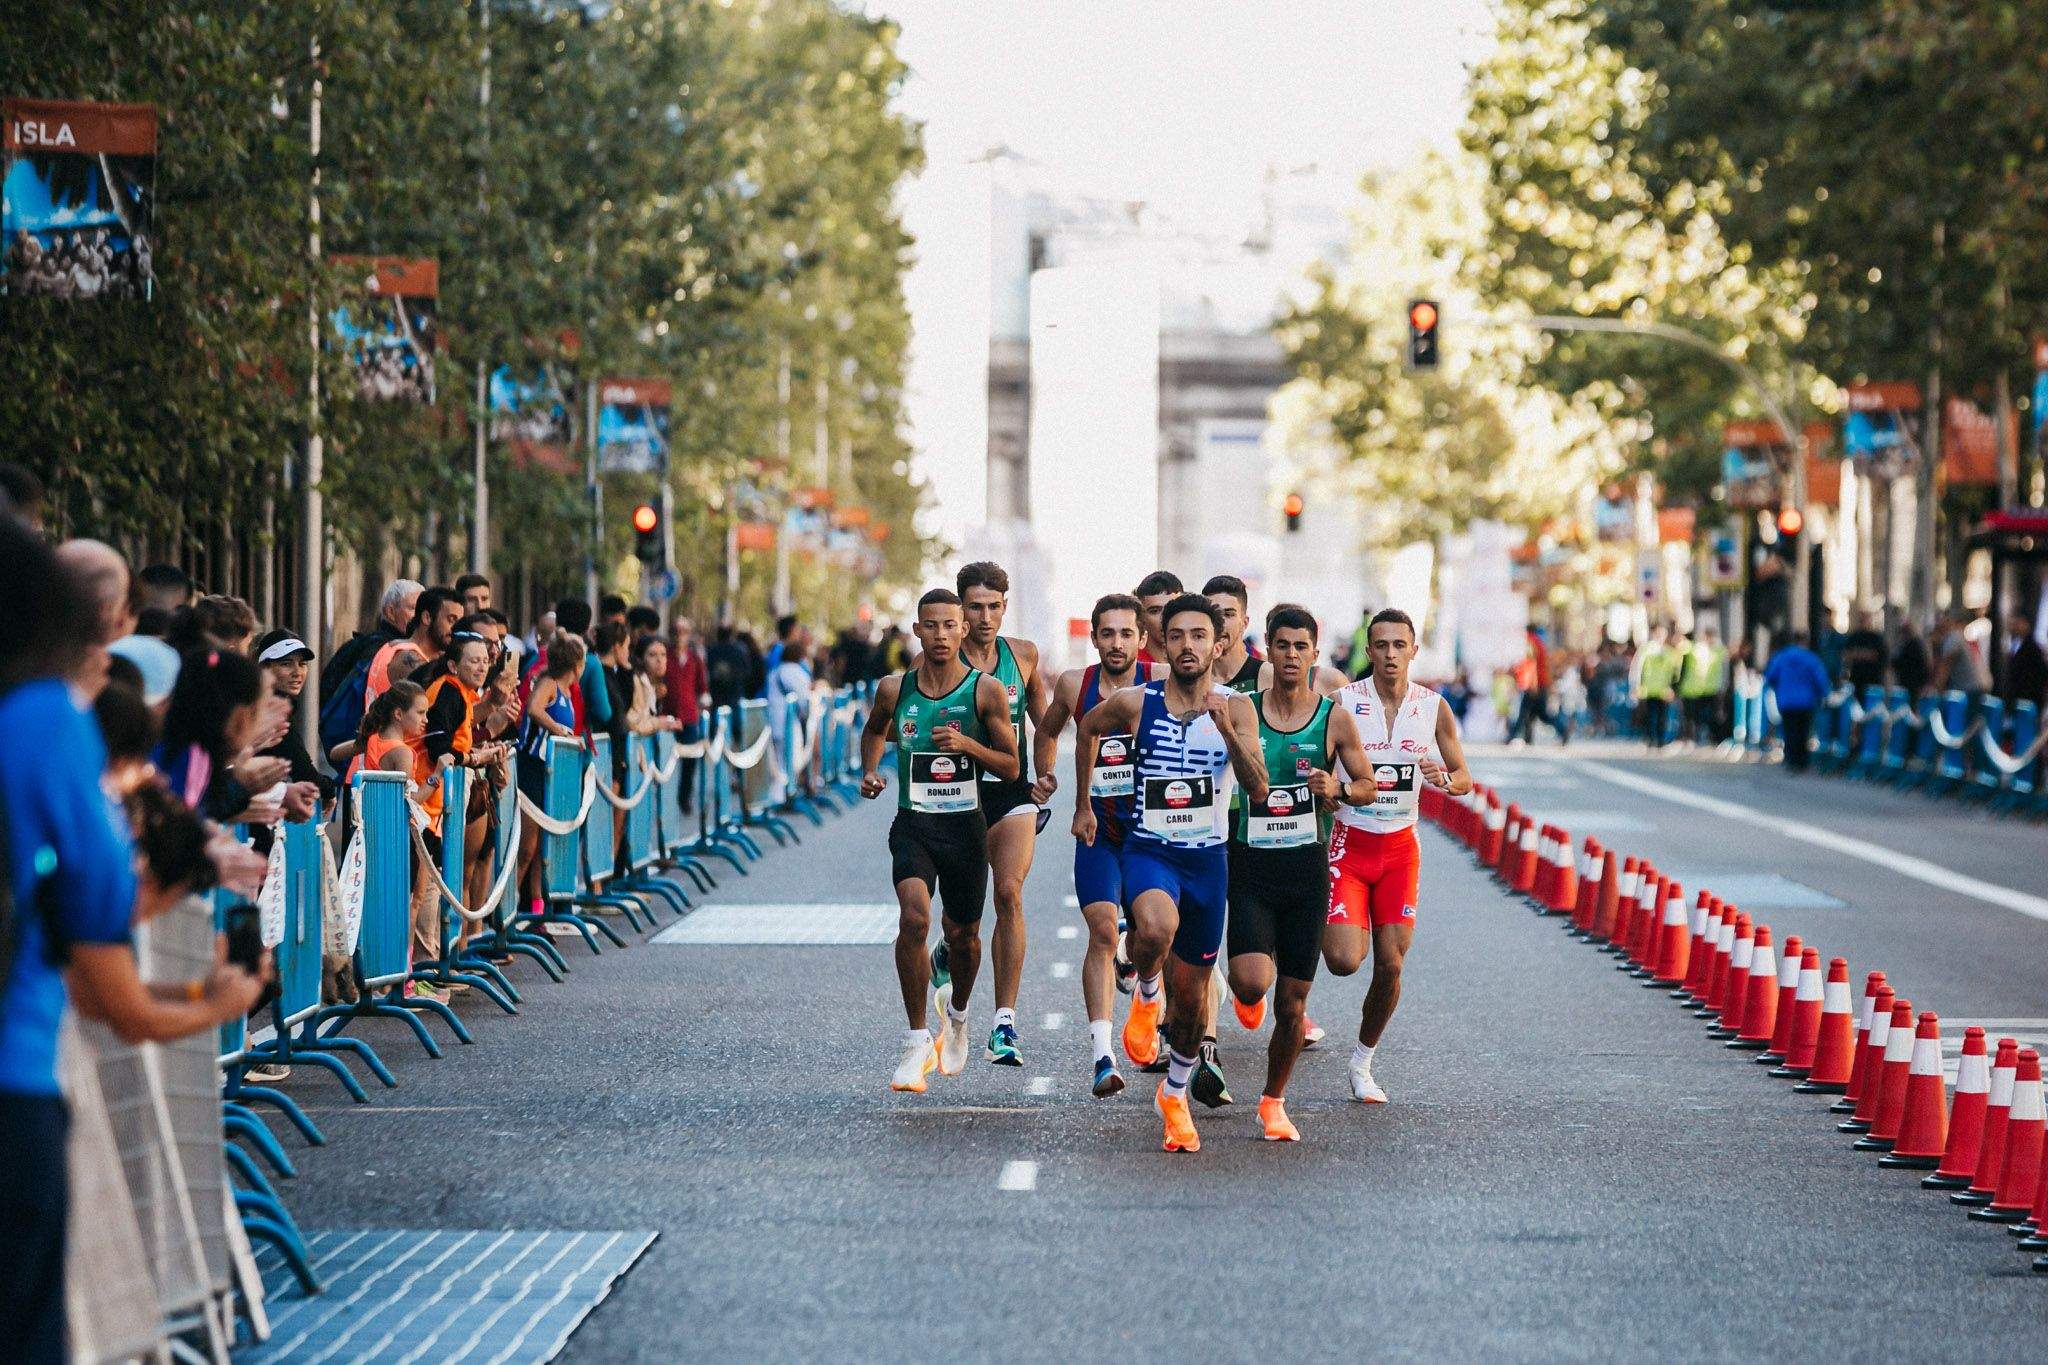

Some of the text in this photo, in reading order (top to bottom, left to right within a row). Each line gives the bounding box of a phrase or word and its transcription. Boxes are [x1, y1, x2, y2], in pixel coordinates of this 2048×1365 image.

[14, 120, 76, 147] ISLA
[1363, 739, 1429, 753] erto Rico
[960, 756, 969, 770] 5
[1102, 770, 1131, 780] GONTXO
[1400, 765, 1413, 780] 12
[927, 787, 961, 797] RONALDO
[1197, 779, 1206, 795] 1
[1295, 786, 1310, 802] 10
[1166, 814, 1193, 824] CARRO
[1266, 821, 1298, 831] ATTAOUI
